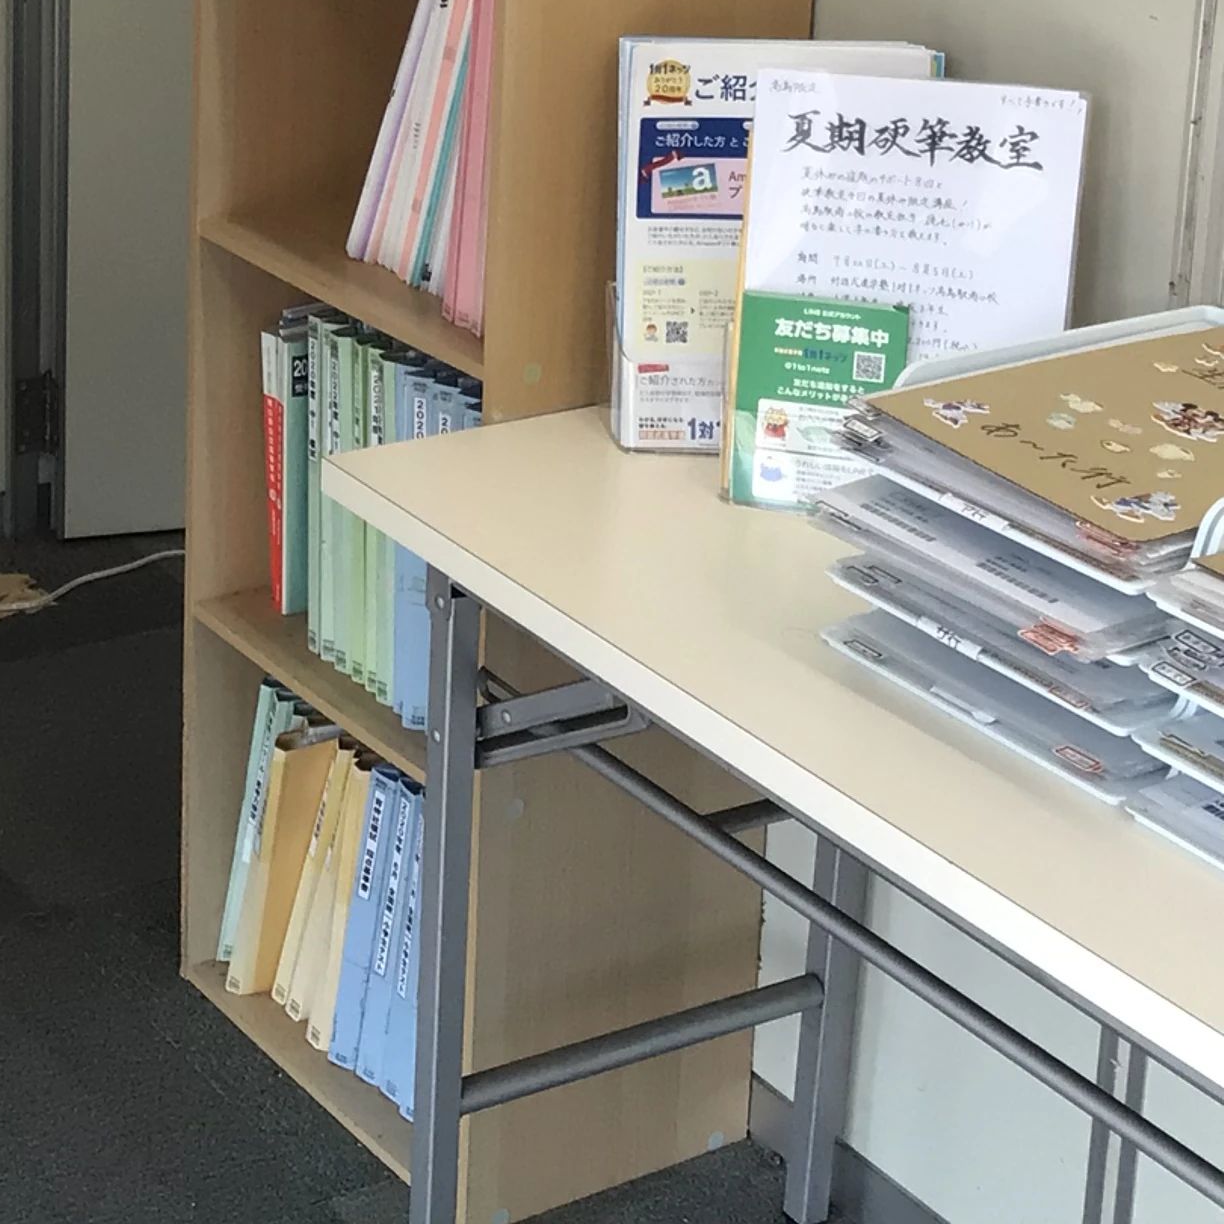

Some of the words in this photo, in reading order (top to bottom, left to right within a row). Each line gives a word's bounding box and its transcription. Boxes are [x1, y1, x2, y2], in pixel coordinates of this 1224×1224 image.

[655, 133, 725, 148] ご紹介した方
[730, 137, 739, 147] と
[783, 109, 1044, 171] 夏期硬筆教室
[775, 318, 889, 348] 友だち募集中
[687, 417, 720, 440] 1対
